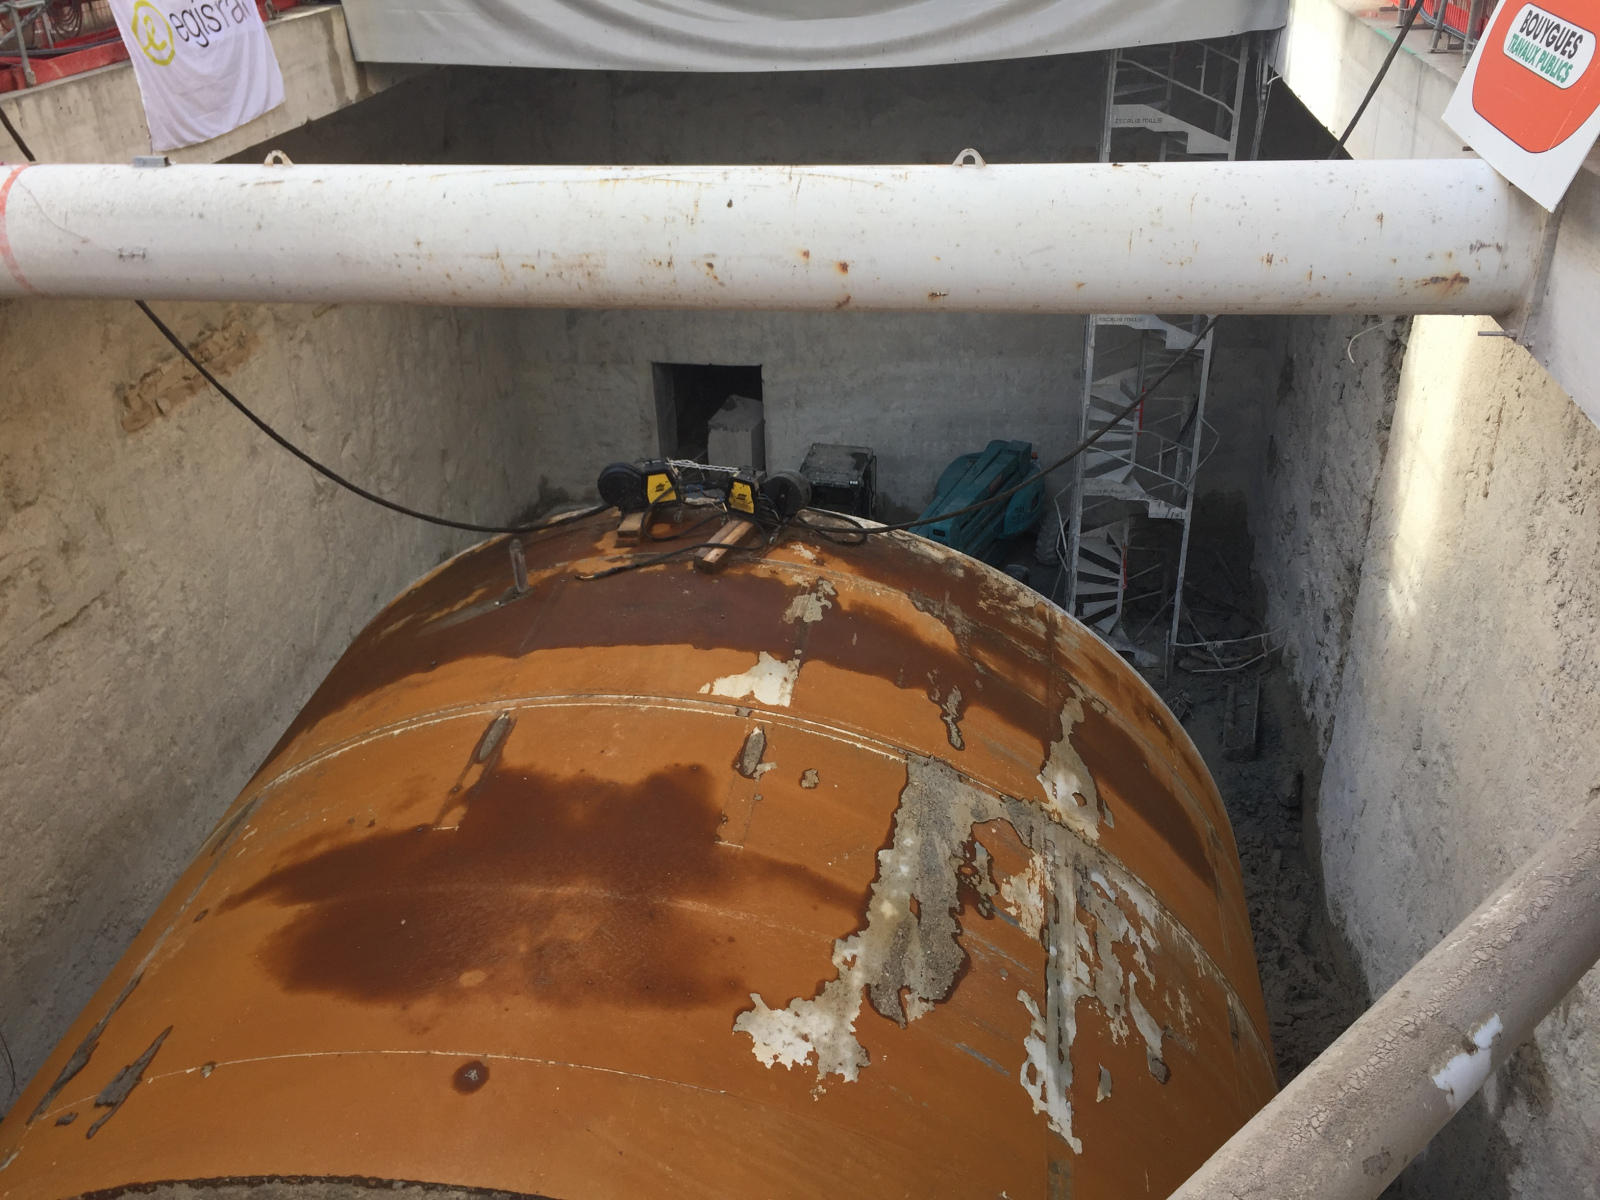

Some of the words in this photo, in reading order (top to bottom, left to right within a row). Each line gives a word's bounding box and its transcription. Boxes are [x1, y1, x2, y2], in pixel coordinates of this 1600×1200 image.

[1507, 33, 1541, 66] TRAVAUX
[1536, 51, 1573, 83] PUBLICS
[1519, 10, 1583, 59] BOUYGUES
